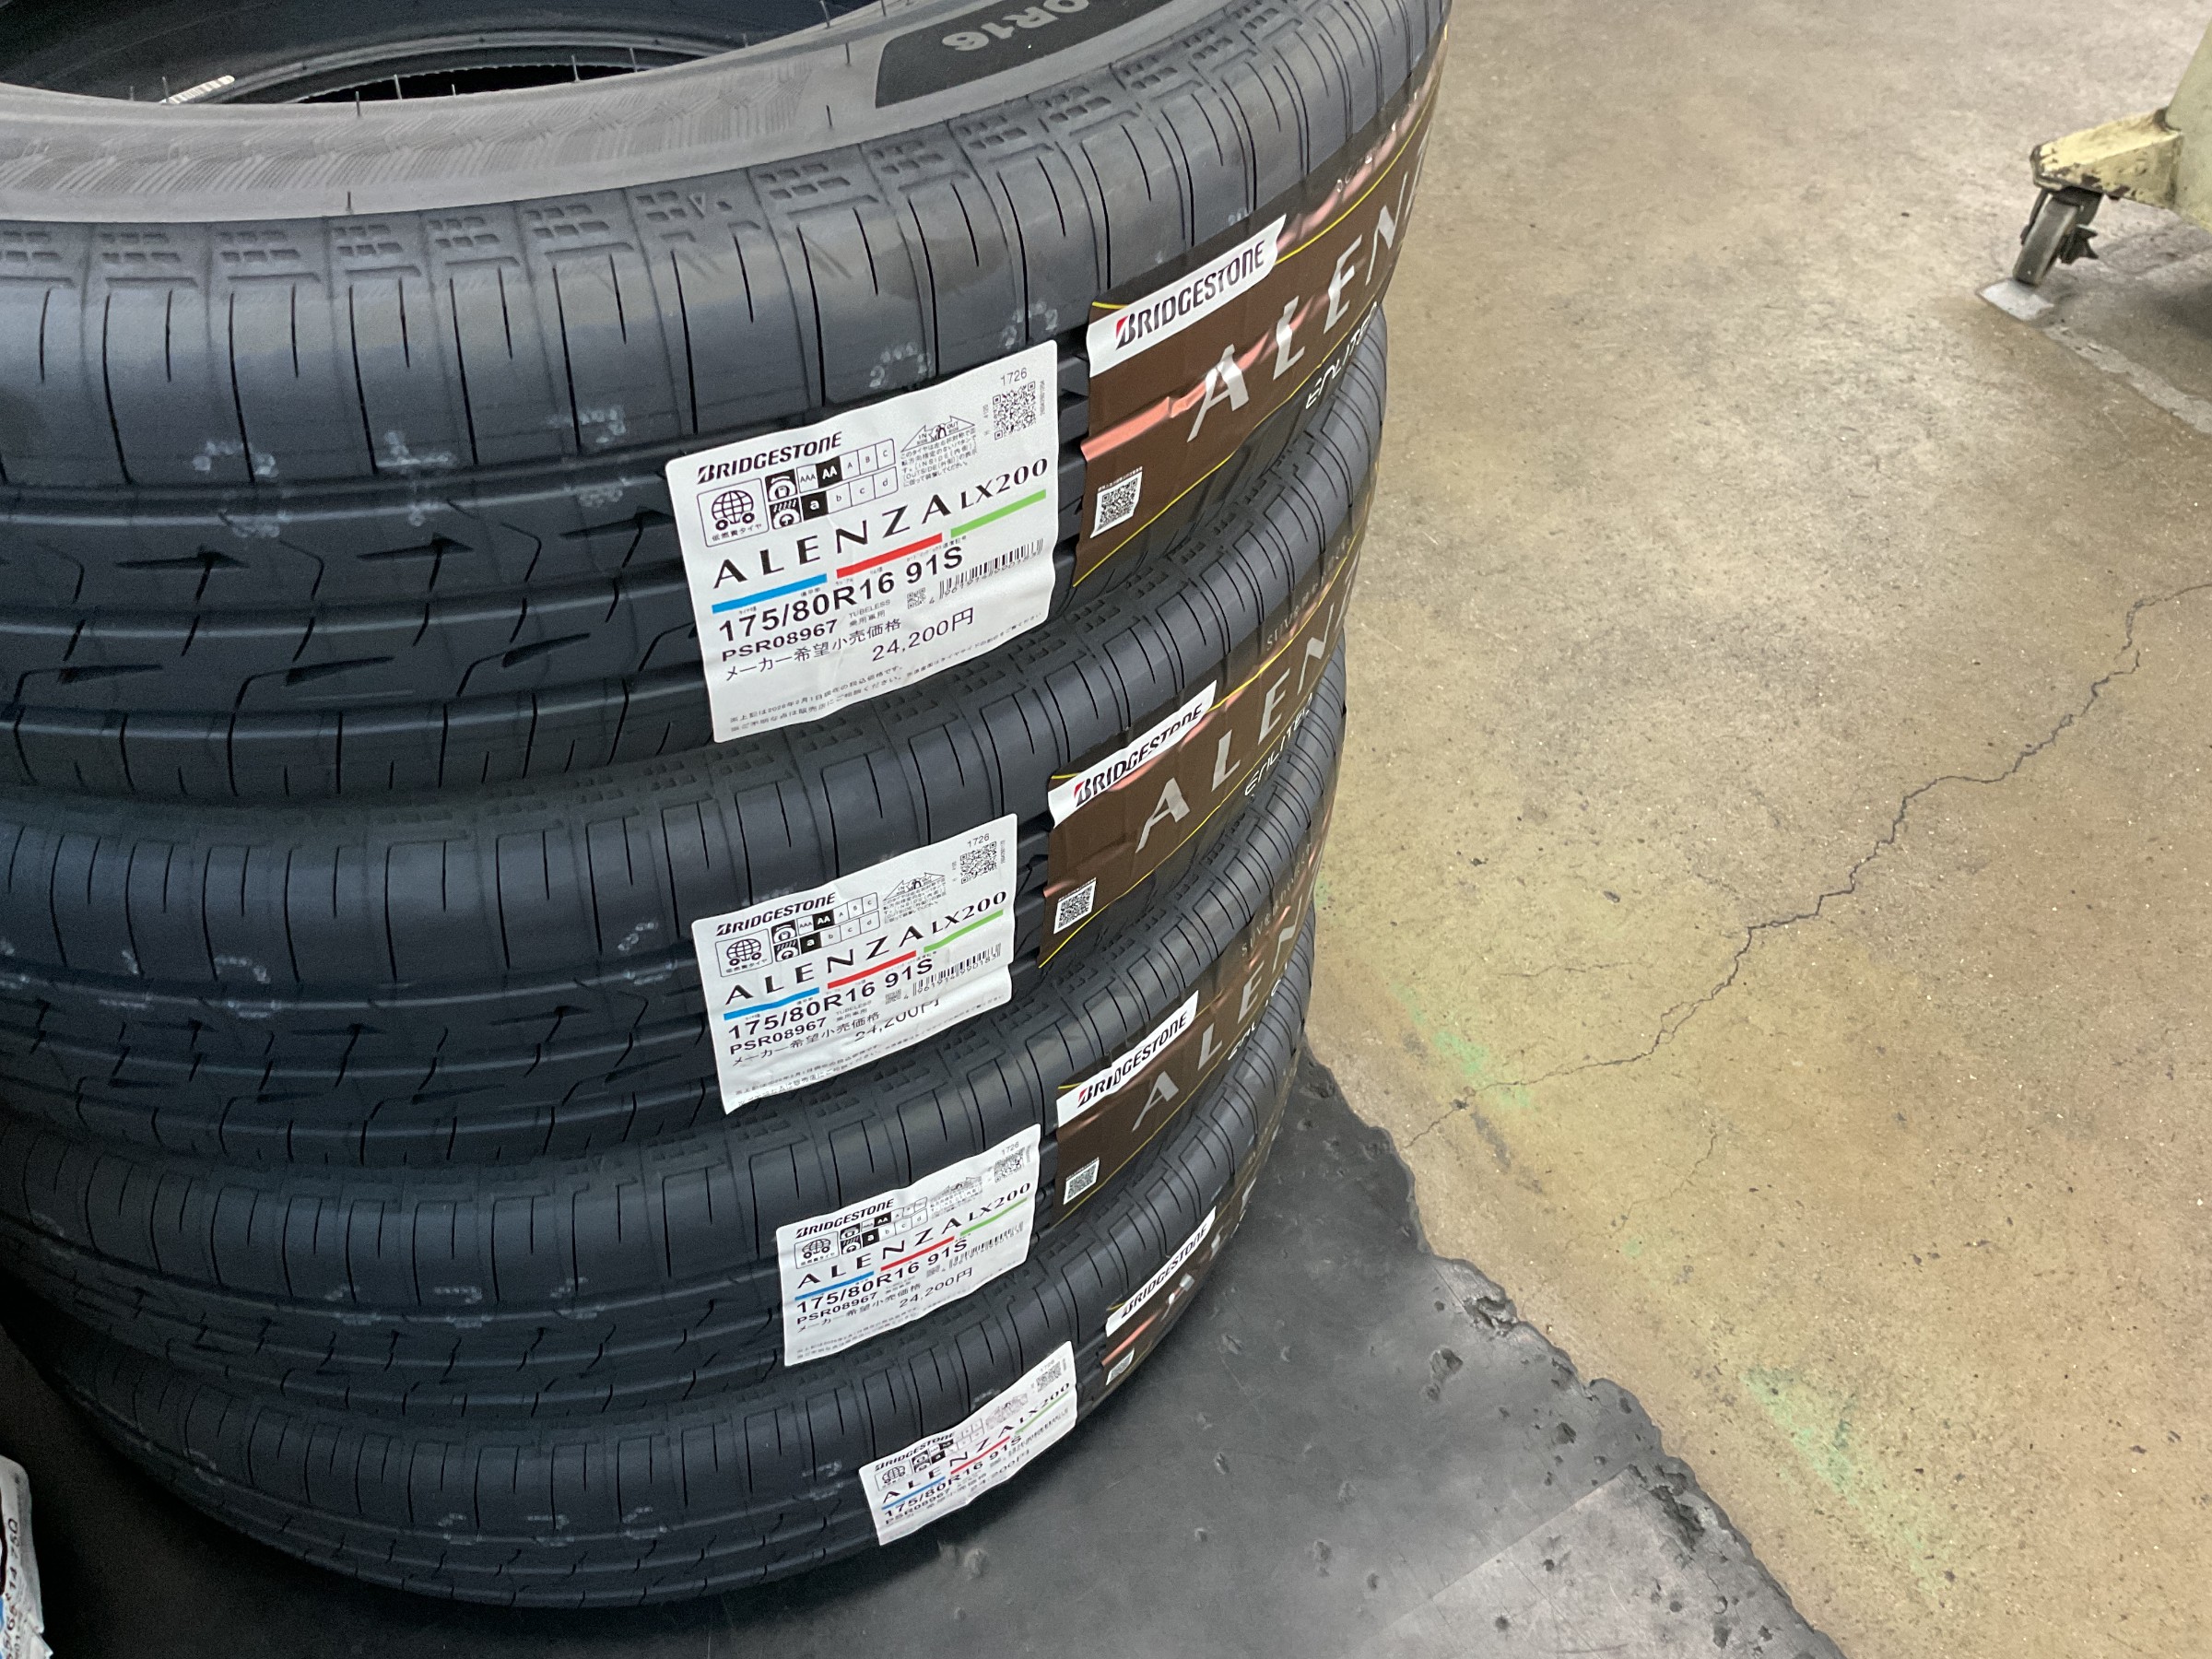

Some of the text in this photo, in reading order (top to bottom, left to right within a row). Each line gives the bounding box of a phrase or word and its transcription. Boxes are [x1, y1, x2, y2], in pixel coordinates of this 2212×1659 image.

[1116, 240, 1265, 349] BRIDGESTONE
[1000, 367, 1028, 386] 1726
[947, 420, 959, 430] OUT
[697, 431, 842, 485] BRIDGESTONE
[800, 474, 816, 483] AAA
[822, 465, 837, 479] AA
[882, 449, 888, 457] C
[810, 499, 819, 511] a
[836, 494, 842, 502] b
[882, 477, 888, 487] d
[712, 458, 1048, 590] ALENZA LX200
[719, 546, 963, 641] 175/80R16 91S
[849, 599, 890, 618] TUBELESS
[722, 618, 838, 662] PSR08967
[726, 618, 900, 681] メーカー希望小売価格
[872, 606, 974, 662] 24,200円
[1074, 702, 1202, 807] BRIDGESTONE
[968, 833, 989, 848] 1726
[716, 892, 835, 936] BRIDGESTONE
[818, 916, 830, 925] AA
[725, 925, 924, 1006] ALENZA
[933, 891, 1006, 934] LX200
[728, 982, 876, 1039] 175/80R16
[885, 958, 933, 988] 91S
[730, 1017, 827, 1055] PSR08967
[733, 1011, 880, 1067] メーカー希望小売価格
[1077, 1010, 1187, 1109] BRIDGESTONE
[795, 1199, 894, 1239] BRIDGESTONE
[797, 1218, 961, 1288] ALENZA
[969, 1182, 1030, 1222] LX200
[797, 1262, 920, 1313] 175/80R16
[928, 1240, 967, 1265] 91S
[900, 1267, 972, 1309] 24,200円
[1122, 1224, 1206, 1317] BRIDGESTONE
[797, 1291, 877, 1324] PSR08967
[875, 1431, 956, 1471] BRIDGESTONE
[883, 1425, 1014, 1503] ALENZA
[885, 1462, 983, 1516] 175/80R16
[990, 1436, 1021, 1459] 91S
